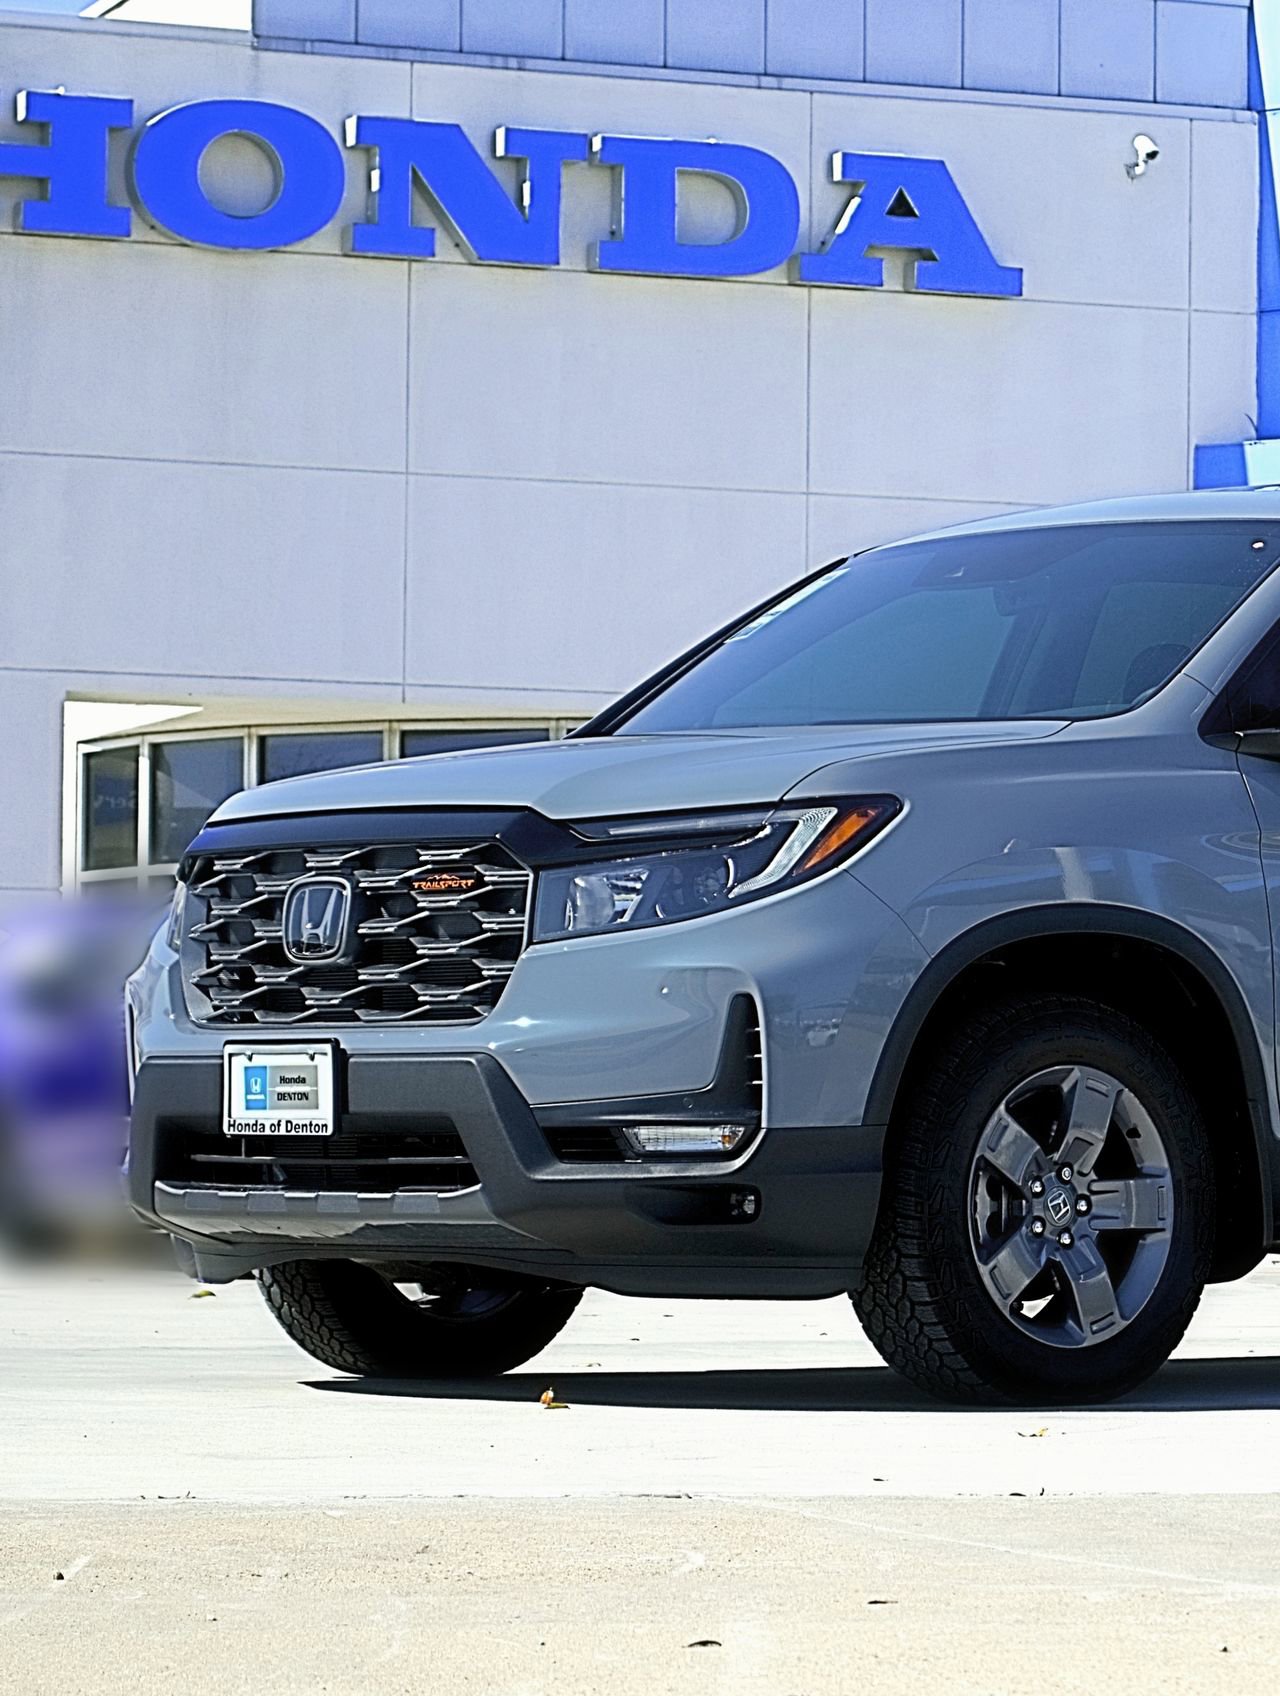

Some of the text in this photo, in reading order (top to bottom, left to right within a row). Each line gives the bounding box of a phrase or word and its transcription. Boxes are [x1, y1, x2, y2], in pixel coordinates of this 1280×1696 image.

[0, 88, 1024, 297] HONDA
[412, 880, 475, 890] TRAILSPORT
[279, 1075, 306, 1084] Honda
[277, 1092, 309, 1101] DENTON
[228, 1120, 328, 1133] Honda of Denton
